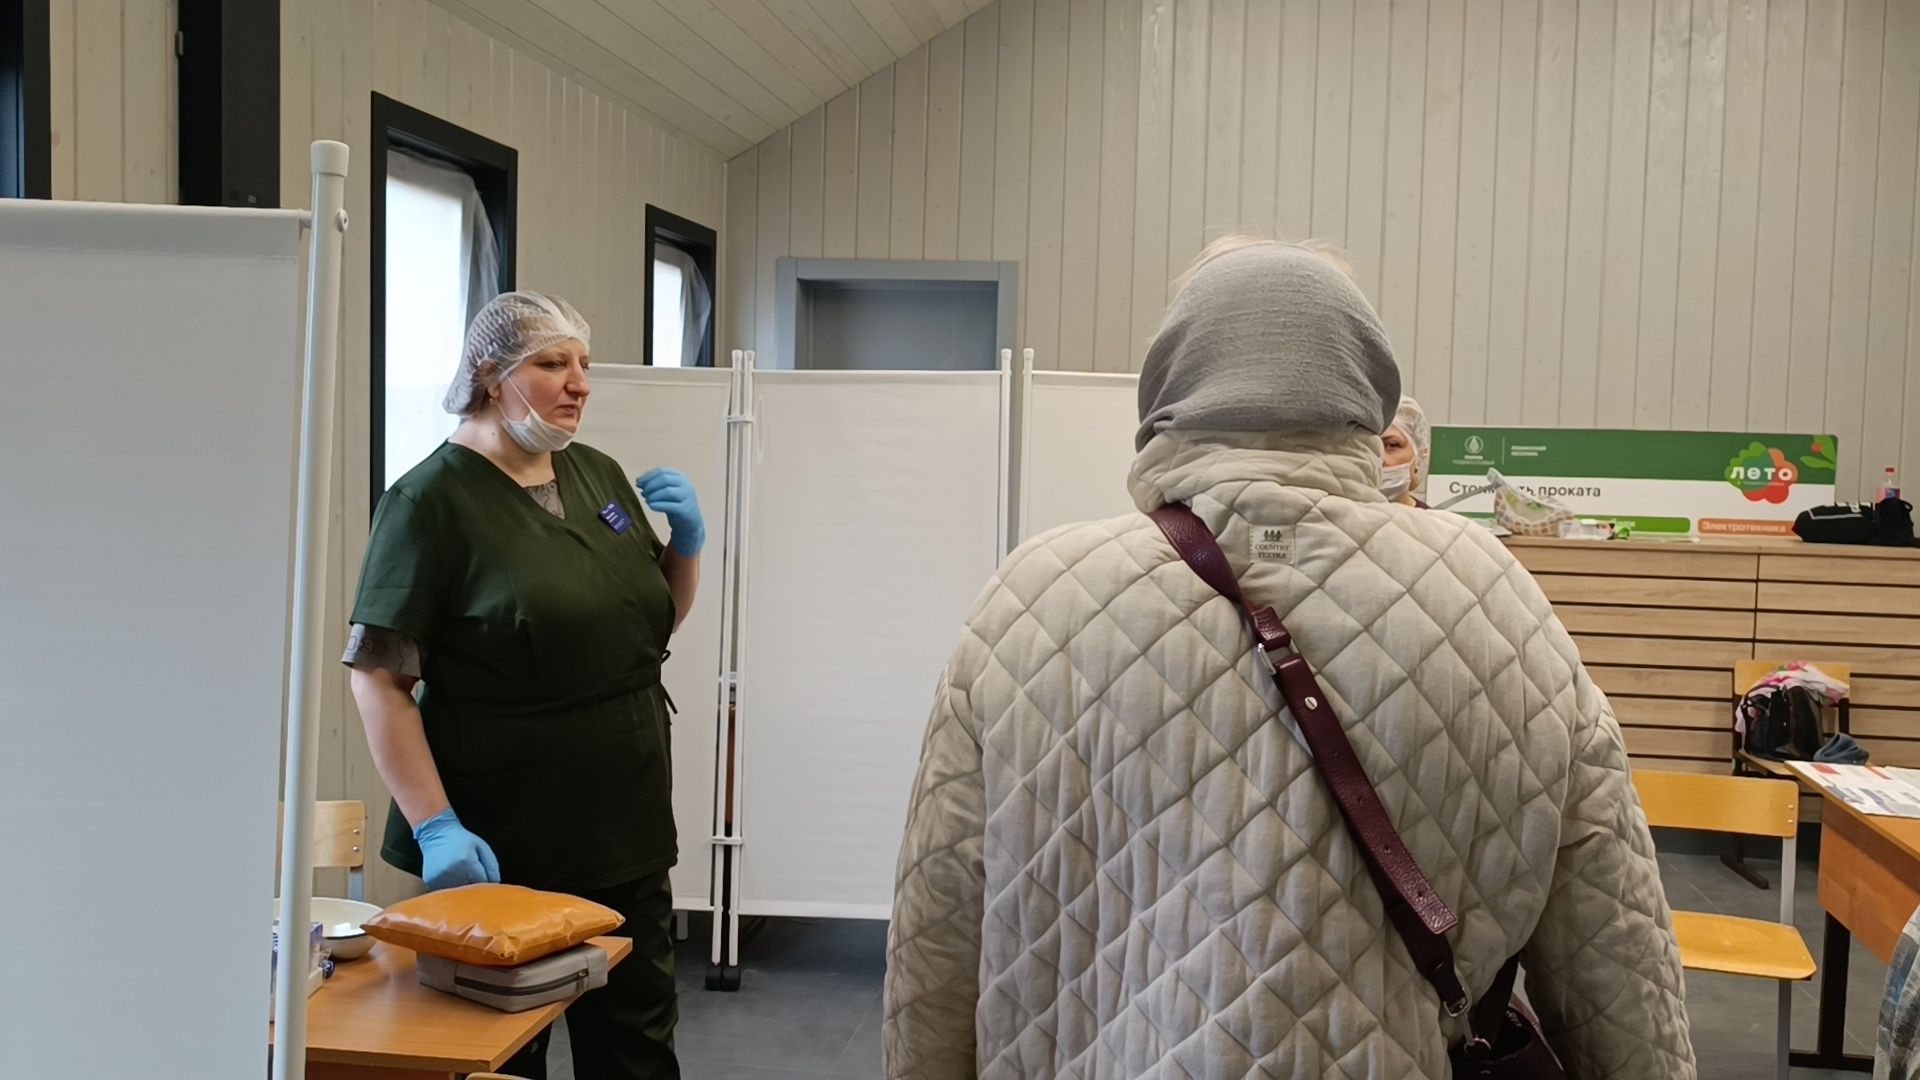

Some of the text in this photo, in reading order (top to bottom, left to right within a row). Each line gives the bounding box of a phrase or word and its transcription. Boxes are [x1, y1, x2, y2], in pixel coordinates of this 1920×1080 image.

[1449, 481, 1601, 498] Стоть проката
[1702, 521, 1786, 532] Электротехника
